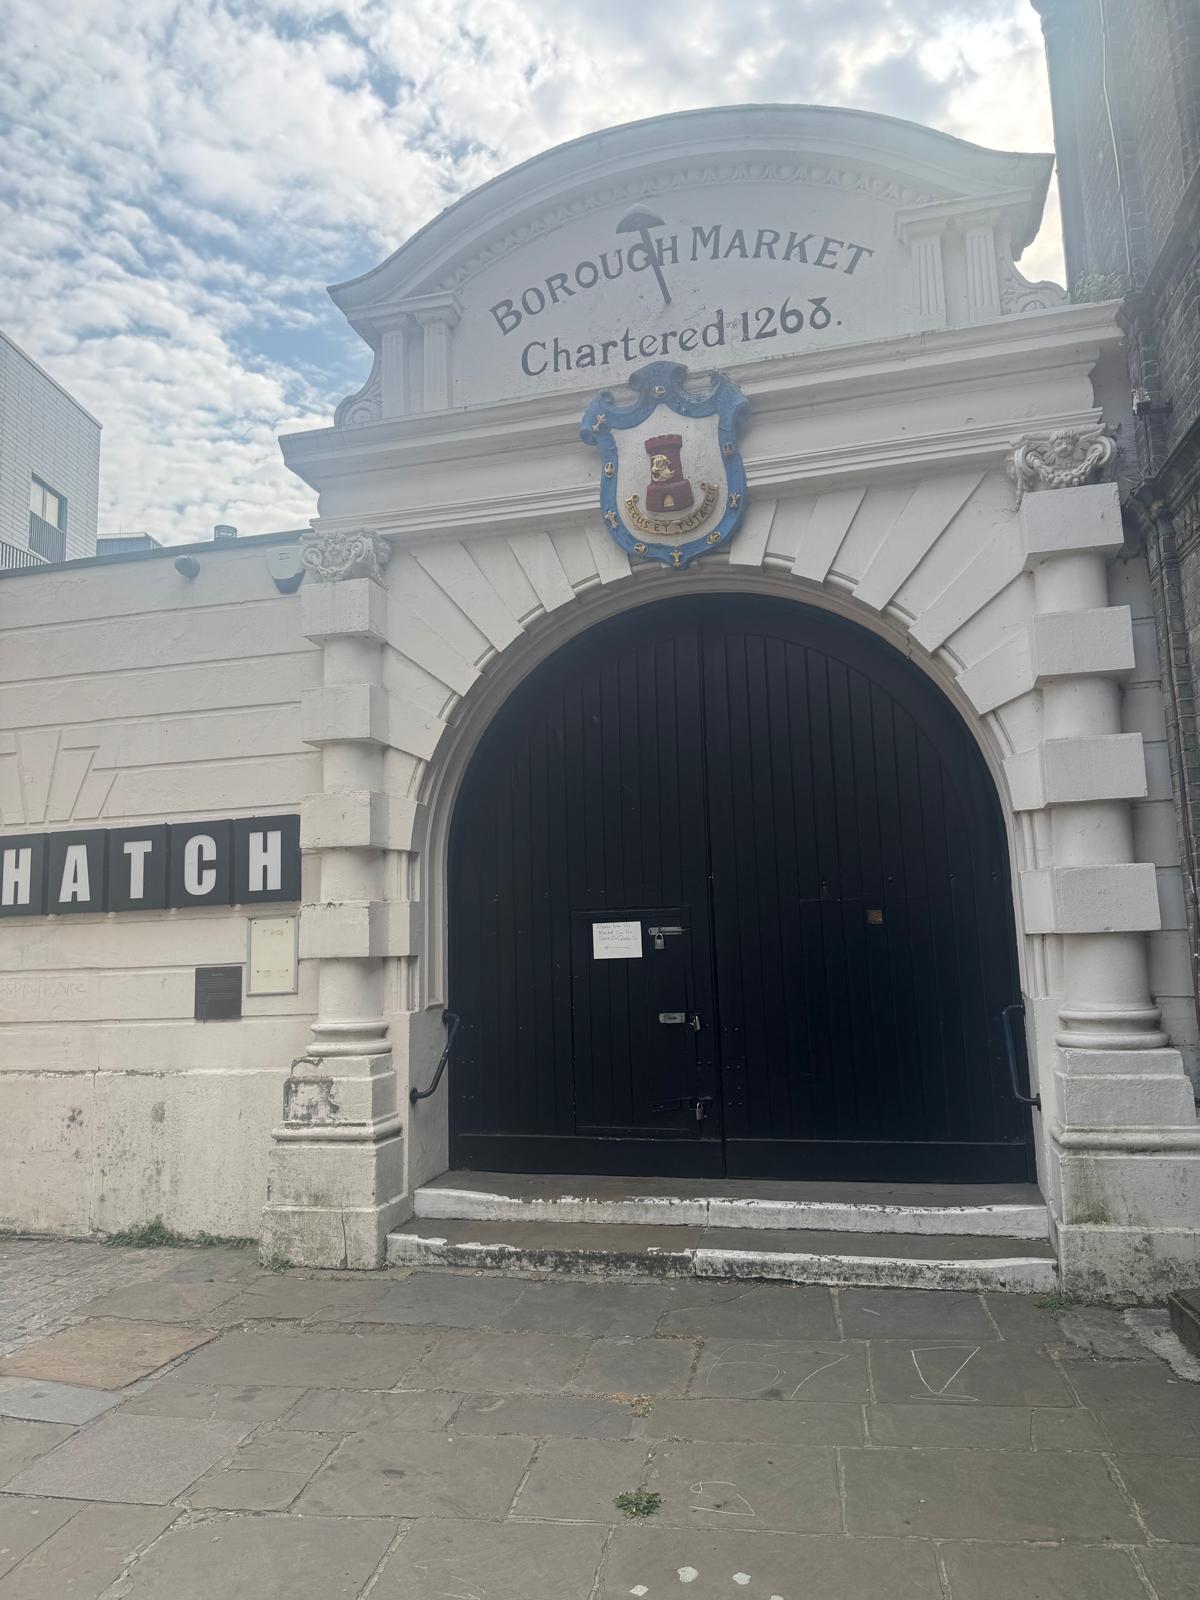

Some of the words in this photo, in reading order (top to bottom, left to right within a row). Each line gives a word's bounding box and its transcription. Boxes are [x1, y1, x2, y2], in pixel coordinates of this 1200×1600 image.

[489, 235, 680, 336] BOROUGH
[690, 224, 874, 275] MARKET
[521, 308, 726, 377] Chartered
[626, 499, 651, 529] DECUS
[654, 523, 670, 533] ET
[676, 487, 716, 531] TUTAMEN
[1, 830, 282, 905] HATCH
